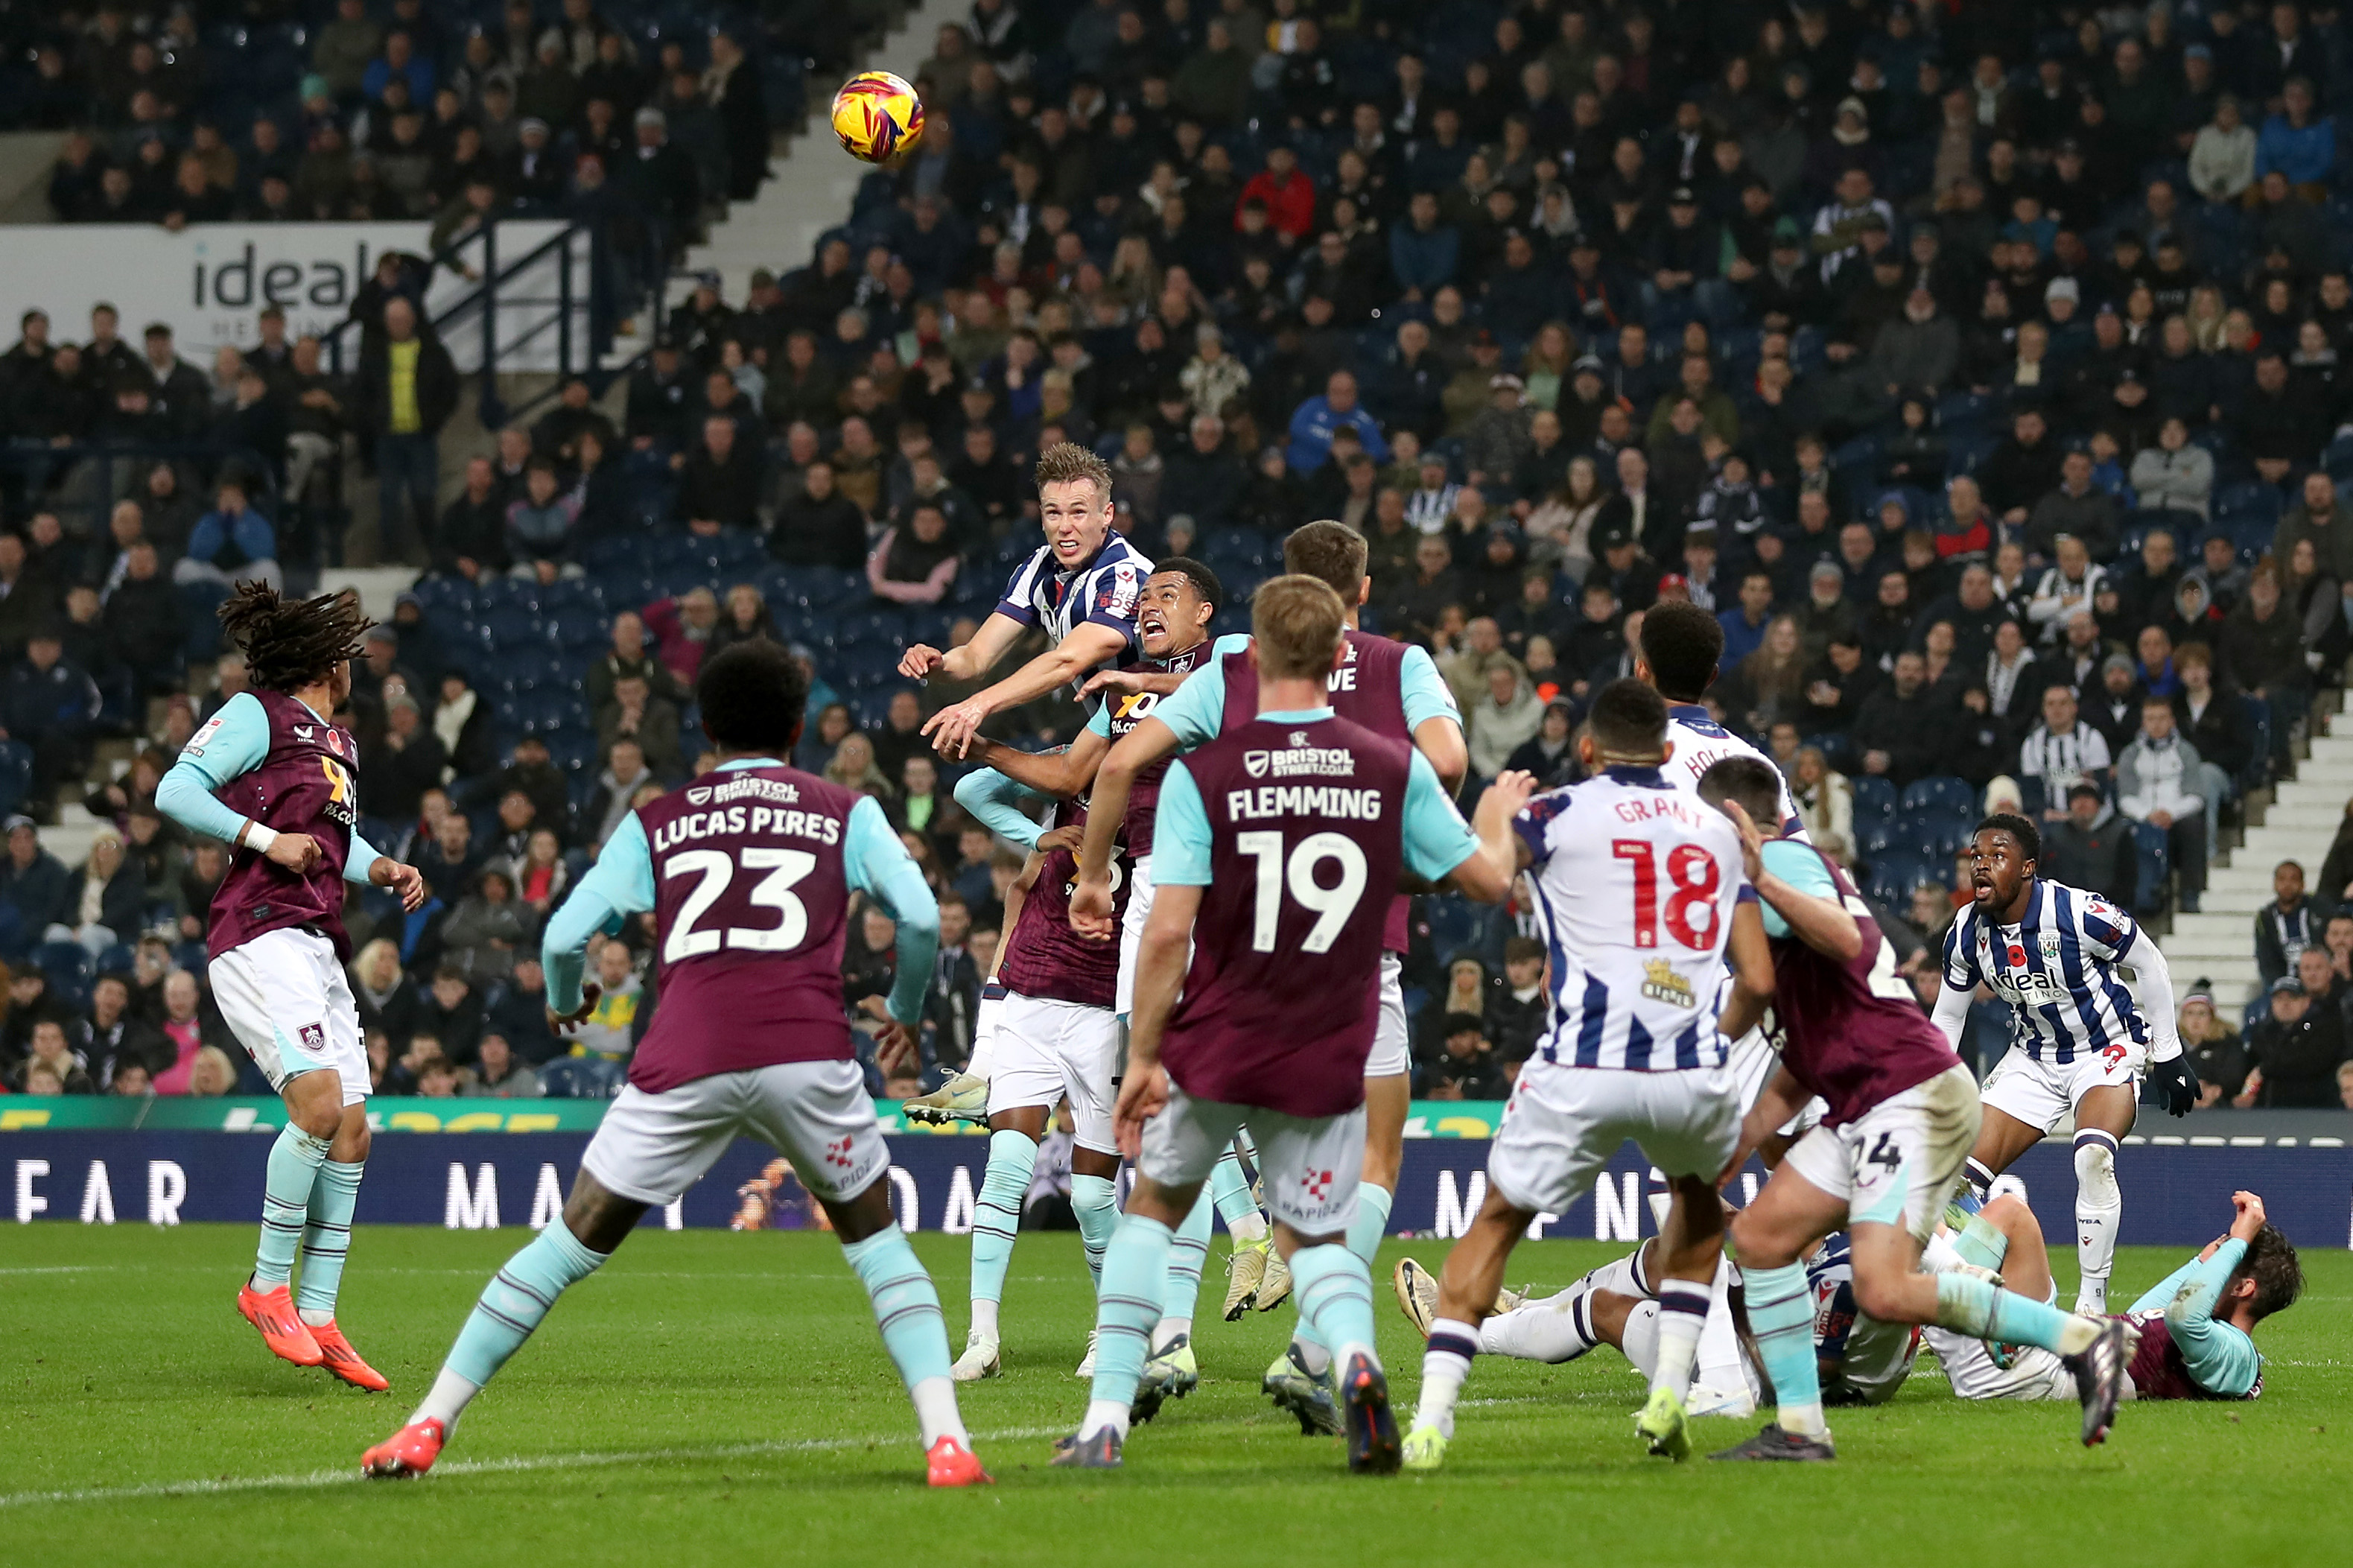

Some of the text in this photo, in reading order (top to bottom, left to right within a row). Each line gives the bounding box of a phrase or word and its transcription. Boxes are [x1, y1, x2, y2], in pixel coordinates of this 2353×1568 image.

[194, 240, 369, 308] ideal
[1271, 748, 1355, 765] BRISTOL
[1272, 763, 1355, 778] STREET.CO.UK
[714, 778, 800, 795] BRISTOL
[1227, 785, 1382, 822] FLEMMING
[653, 805, 841, 852] LUCAS PIRES
[1614, 797, 1704, 829] GRANT
[664, 846, 817, 964] 23
[1236, 831, 1368, 953] 19
[1611, 838, 1720, 951] 18
[1990, 968, 2058, 990] ideal
[2001, 989, 2063, 1002] HETING
[1852, 1131, 1902, 1180] 24
[15, 1159, 187, 1225] FAR
[1283, 1202, 1341, 1218] RAPIDZ
[2077, 1217, 2103, 1226] WBA
